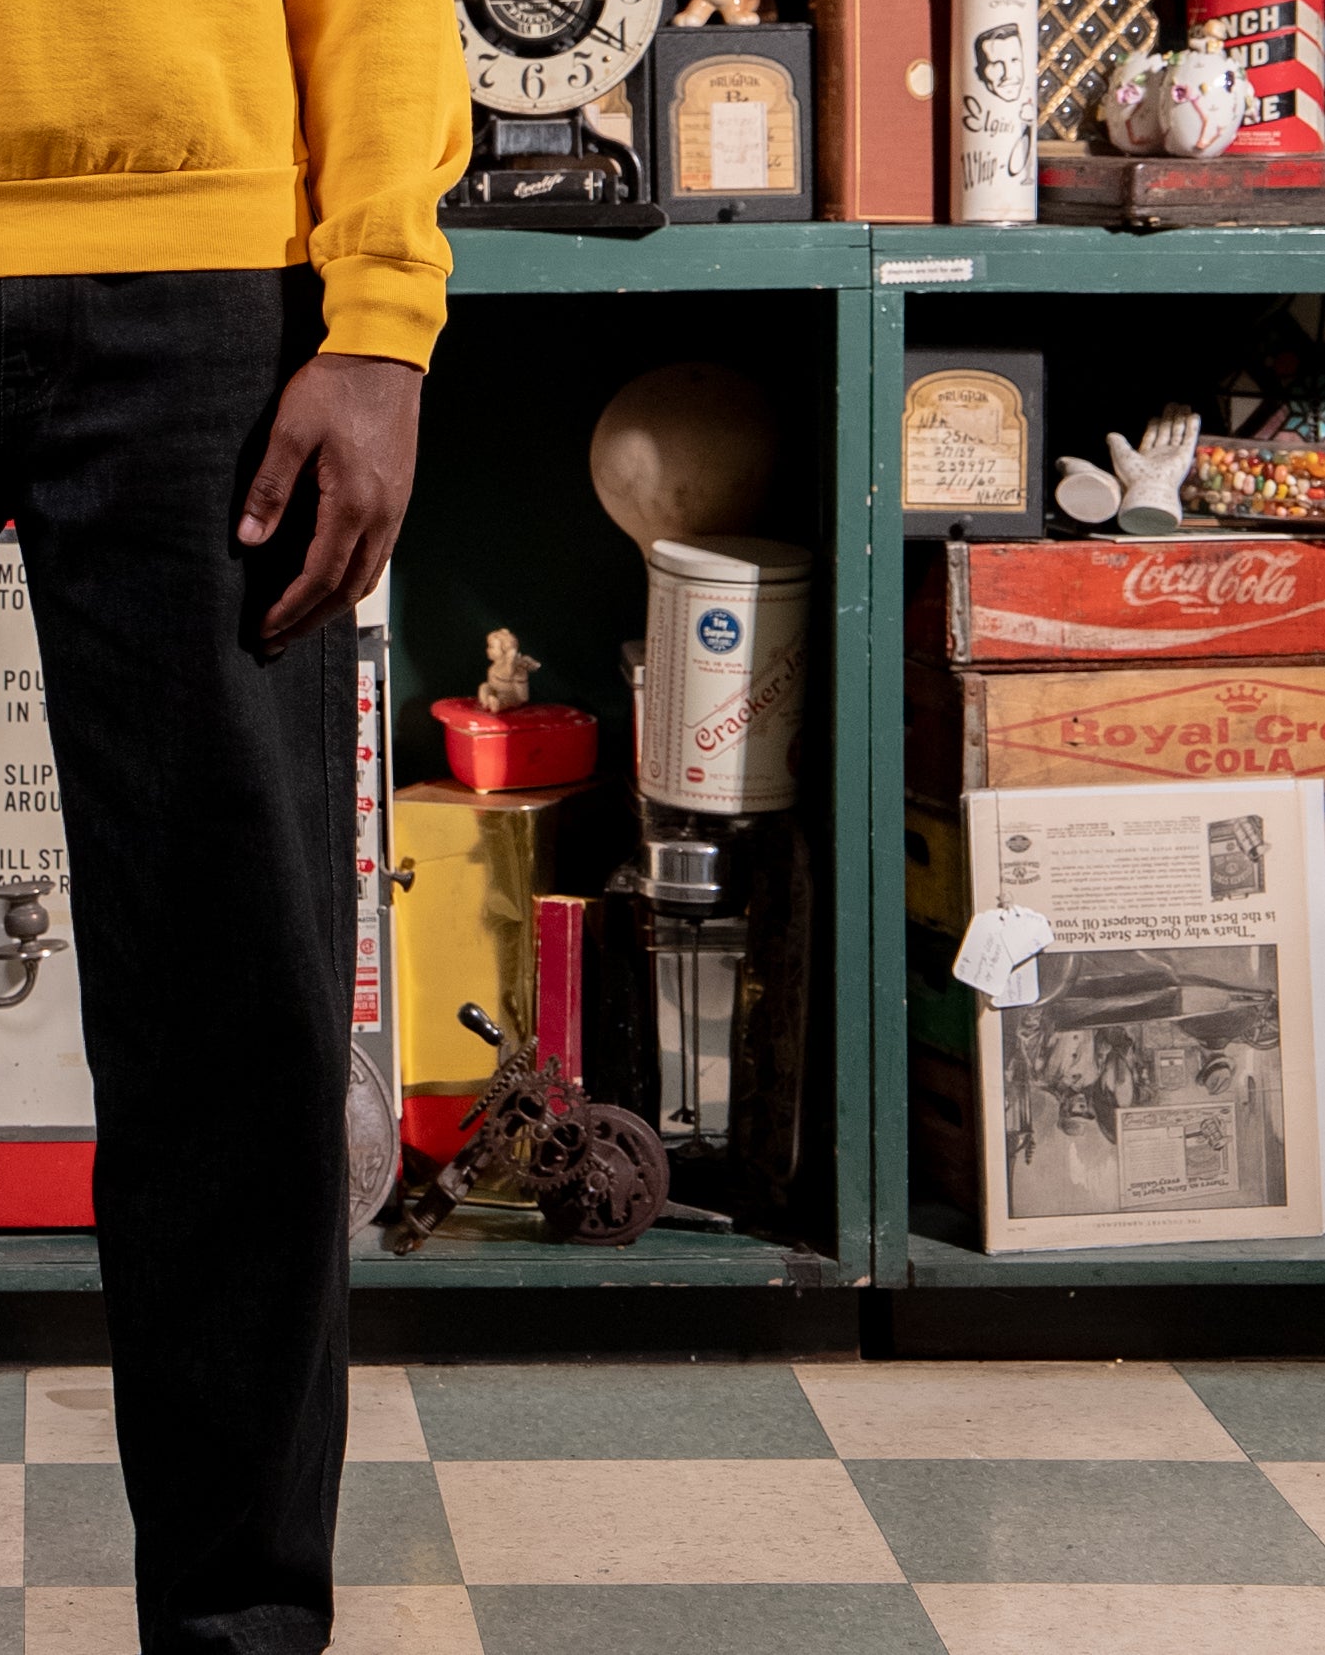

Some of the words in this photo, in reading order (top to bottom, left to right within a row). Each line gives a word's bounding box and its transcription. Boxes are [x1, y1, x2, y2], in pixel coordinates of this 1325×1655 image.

[477, 53, 500, 89] 7
[567, 51, 593, 88] 5
[521, 62, 545, 101] 6
[1122, 548, 1304, 608] Coca-Cola
[0, 589, 25, 610] TO
[7, 702, 29, 722] IN
[695, 675, 781, 752] Cracker
[1060, 716, 1230, 755] Royal
[1254, 713, 1325, 745] Cr
[1185, 748, 1296, 774] COLA
[5, 764, 53, 786] SLIP
[1055, 916, 1079, 929] you
[1081, 917, 1100, 930] Oil
[1102, 913, 1158, 930] Cheapest
[1160, 915, 1181, 927] the
[1183, 914, 1208, 927] and
[1210, 912, 1238, 925] Best
[1240, 912, 1262, 923] the
[1264, 911, 1276, 922] is
[1098, 929, 1132, 942] State
[1135, 927, 1181, 942] Quaker
[1183, 926, 1210, 941] why
